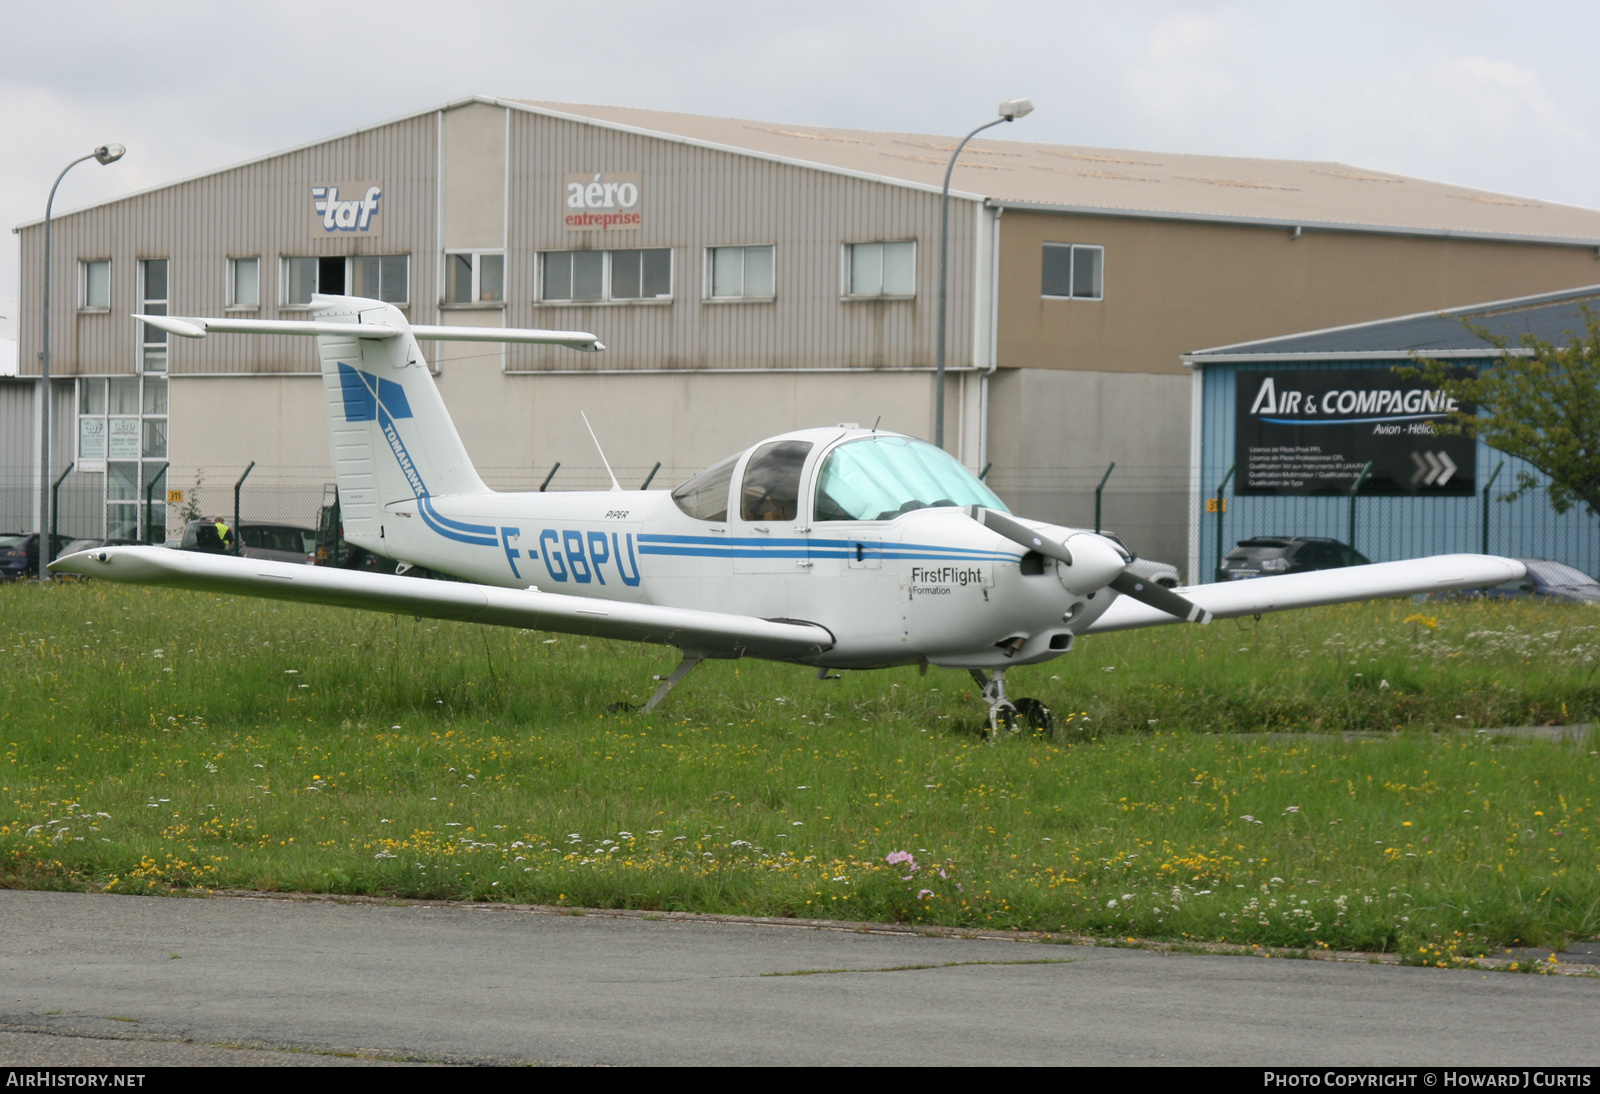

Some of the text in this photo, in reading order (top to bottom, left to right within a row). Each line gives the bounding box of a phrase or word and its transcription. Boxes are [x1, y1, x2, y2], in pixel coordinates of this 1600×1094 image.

[566, 173, 639, 209] aéro
[311, 185, 382, 231] taf
[565, 209, 641, 229] entreprise
[1251, 377, 1460, 414] AIR & COMPAGNIE
[1373, 423, 1401, 434] Avion
[384, 423, 425, 497] TOMAHAWK
[170, 491, 181, 501] 311
[604, 510, 629, 519] PIPER
[500, 526, 641, 587] F-GBPU
[912, 567, 982, 586] FirstFlight
[913, 586, 951, 594] Formation
